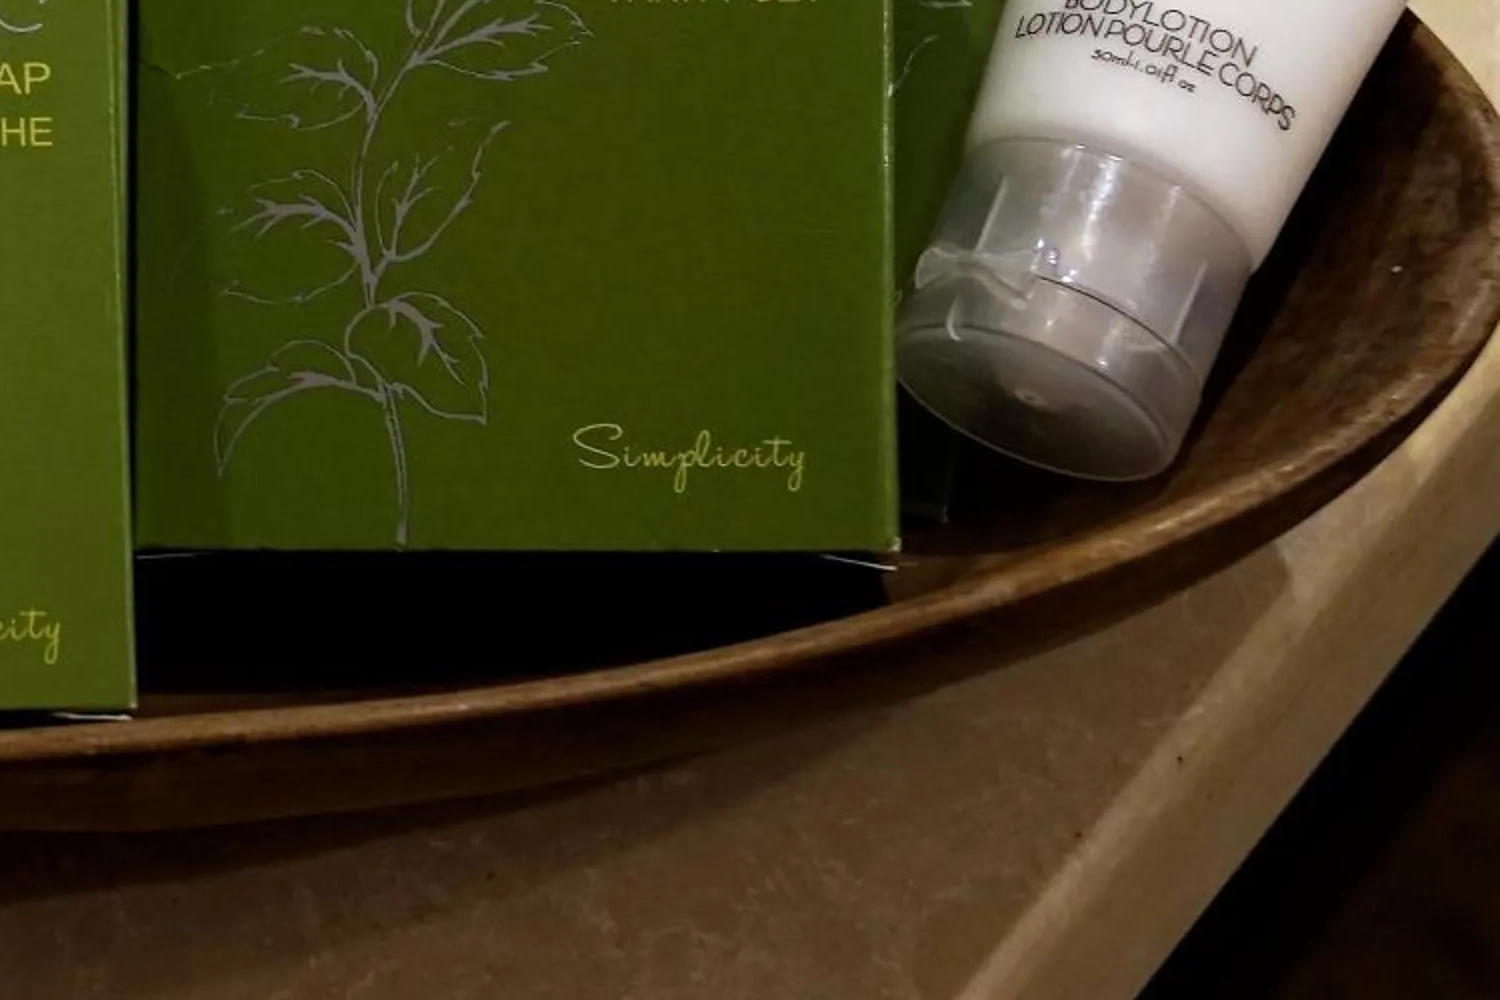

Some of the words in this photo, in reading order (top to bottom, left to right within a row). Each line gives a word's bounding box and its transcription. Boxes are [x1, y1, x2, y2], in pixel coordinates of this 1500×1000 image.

[1014, 12, 1106, 39] LOTION
[1218, 60, 1297, 132] CORPS
[571, 422, 805, 494] Simplicity
